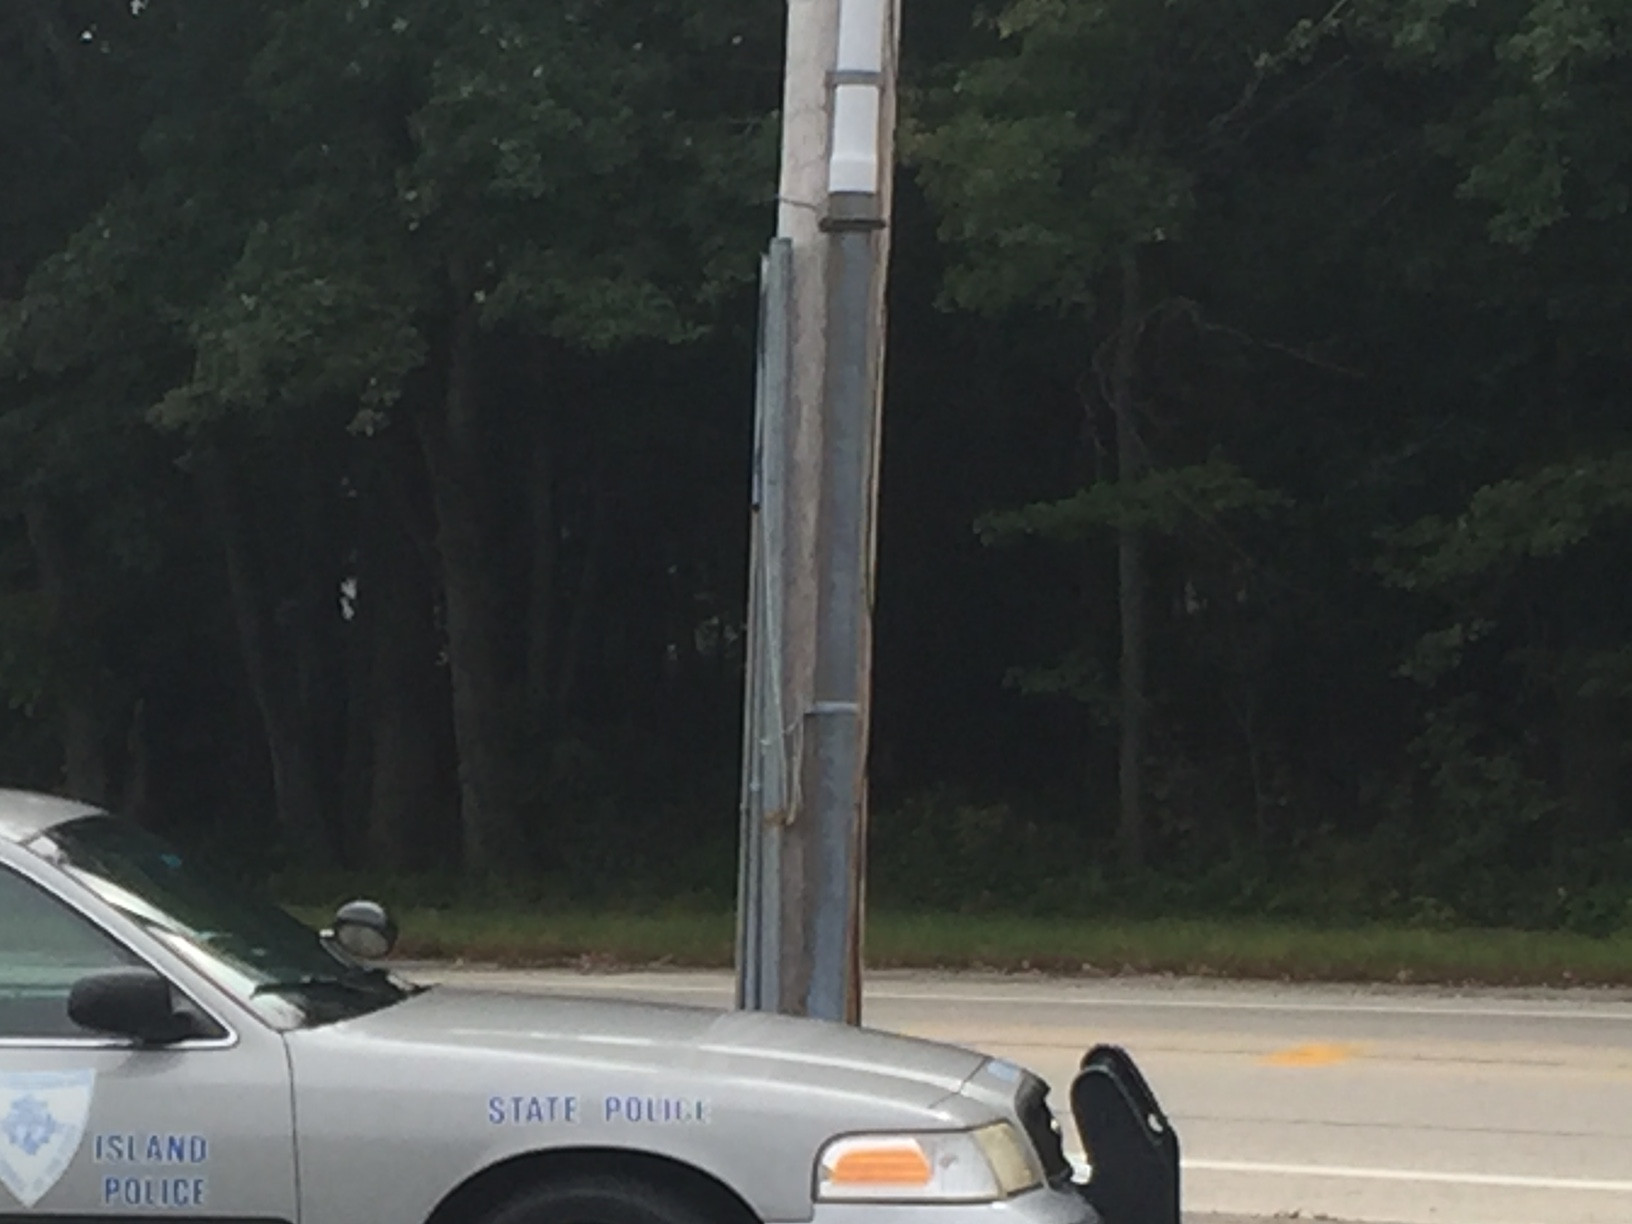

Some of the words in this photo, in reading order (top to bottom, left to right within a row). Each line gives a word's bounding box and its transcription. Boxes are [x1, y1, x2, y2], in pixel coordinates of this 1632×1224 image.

[488, 1095, 578, 1125] STATE
[604, 1095, 709, 1125] POLICE
[93, 1134, 209, 1164] ISLAND
[104, 1177, 207, 1206] POLICE
